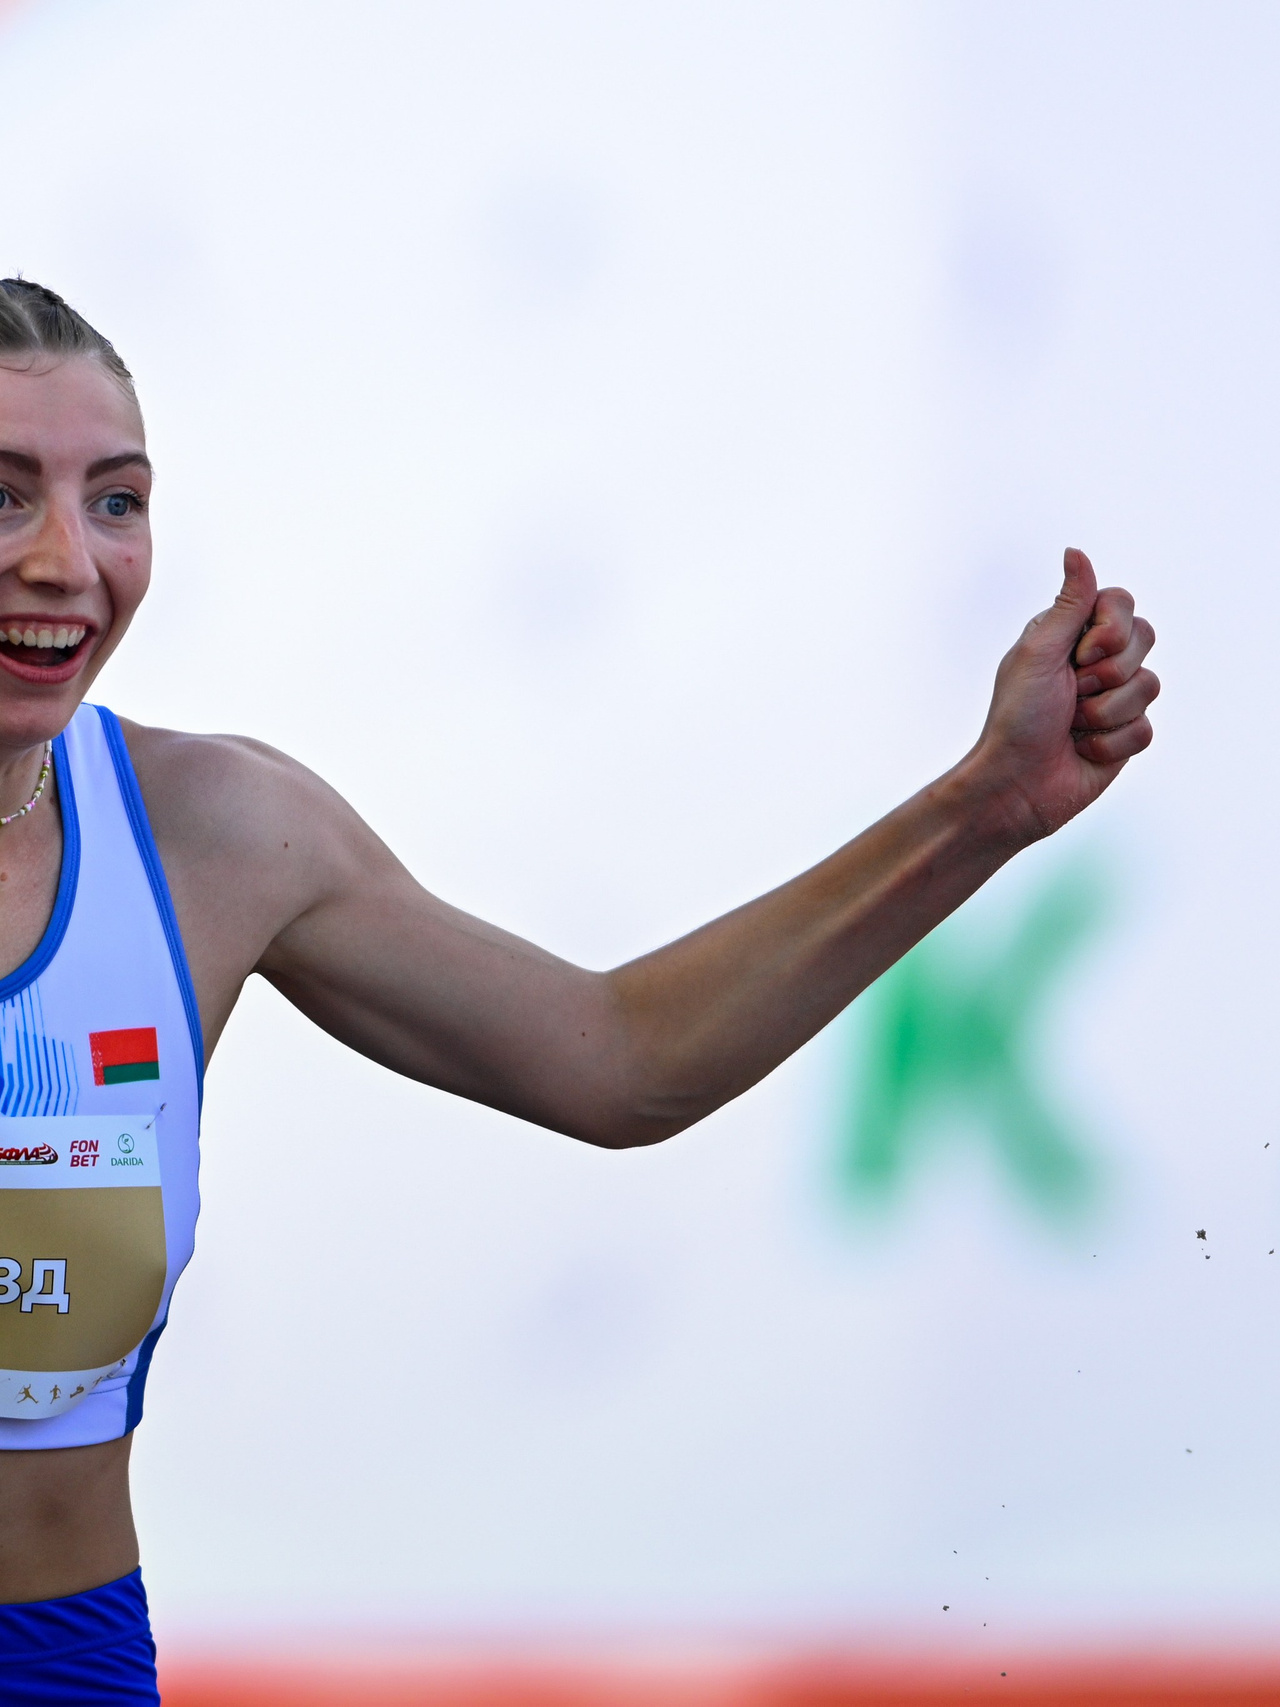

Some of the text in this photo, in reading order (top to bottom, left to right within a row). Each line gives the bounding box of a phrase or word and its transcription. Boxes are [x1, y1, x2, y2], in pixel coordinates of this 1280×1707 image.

[69, 1139, 99, 1153] FON
[70, 1154, 100, 1167] BET
[110, 1157, 144, 1166] DARIDA
